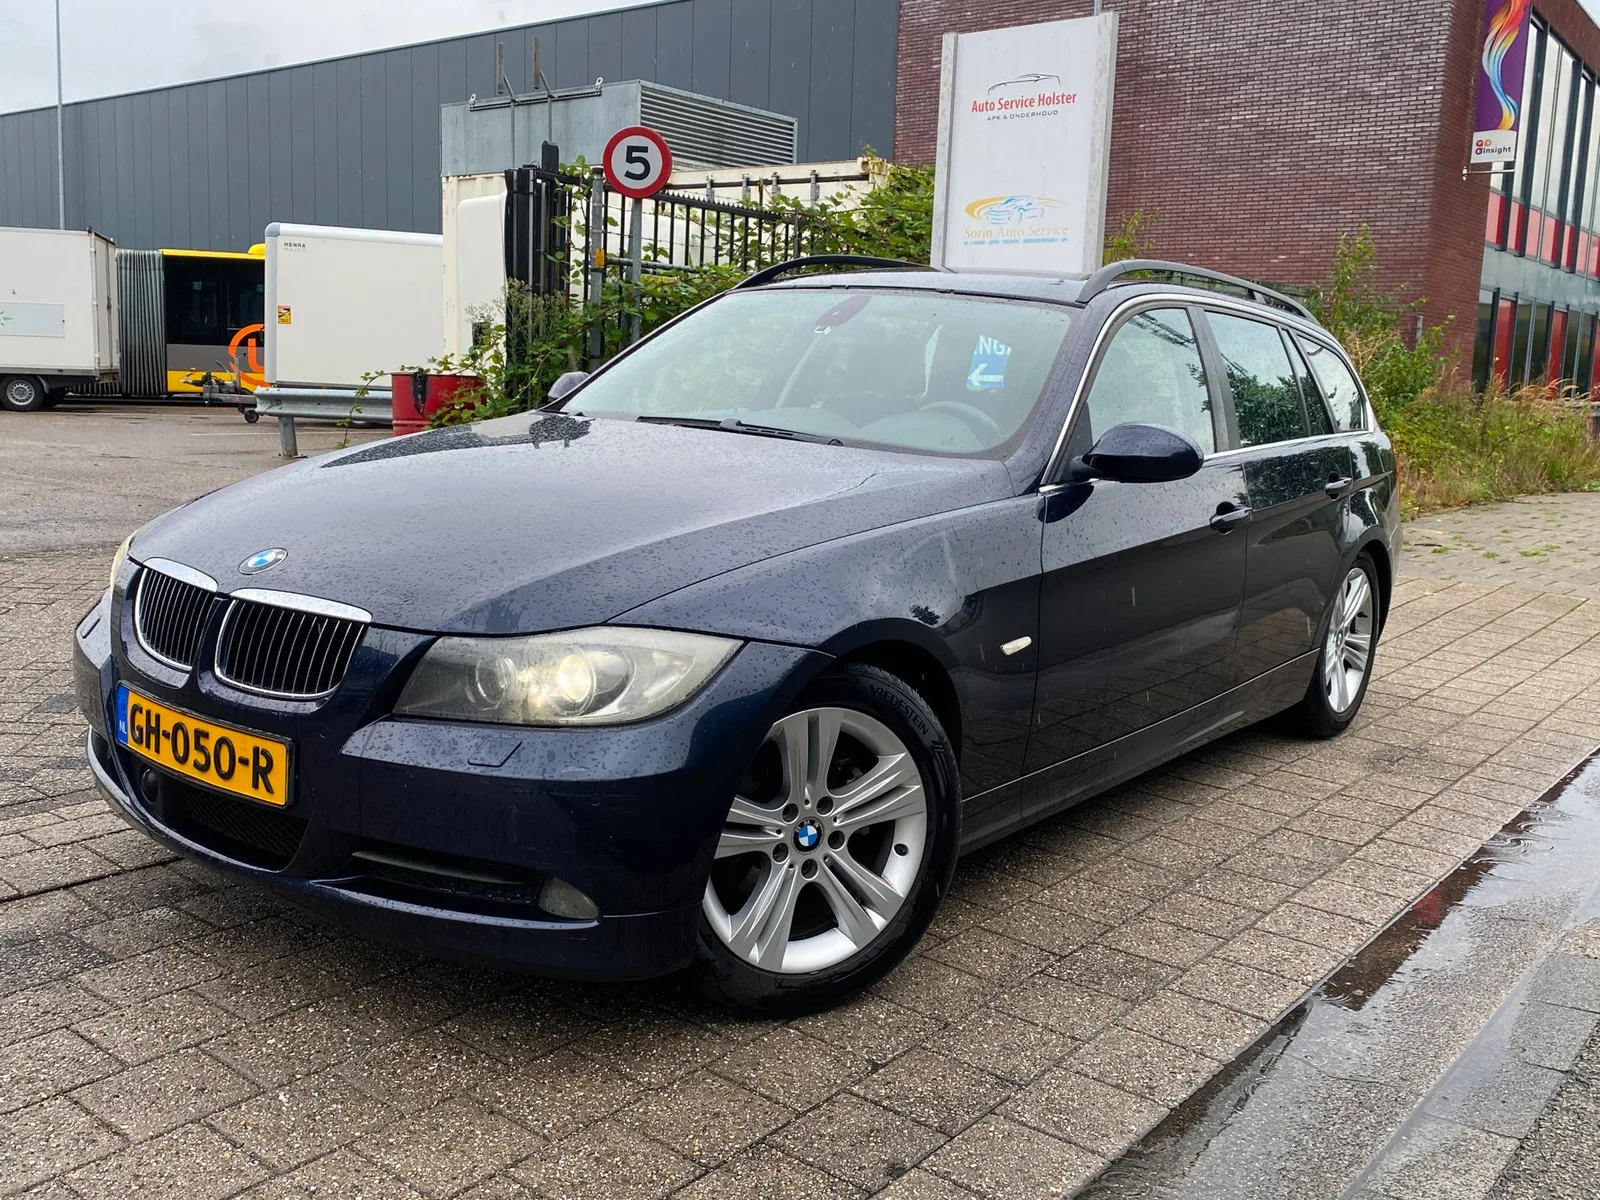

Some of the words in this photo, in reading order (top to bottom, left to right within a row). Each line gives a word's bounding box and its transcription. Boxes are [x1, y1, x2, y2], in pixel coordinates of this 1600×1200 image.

[971, 100, 996, 113] Auto
[997, 95, 1035, 111] Service
[1037, 91, 1078, 107] Holster
[1009, 109, 1059, 120] ONDERHOUD
[1483, 146, 1512, 155] Insight
[624, 145, 651, 181] 5
[964, 226, 993, 239] Sorin
[997, 225, 1025, 238] Auto
[1028, 223, 1069, 237] Service
[868, 683, 930, 736] VREDESTEIN
[119, 719, 127, 735] NL
[129, 702, 275, 795] GH-050-R
